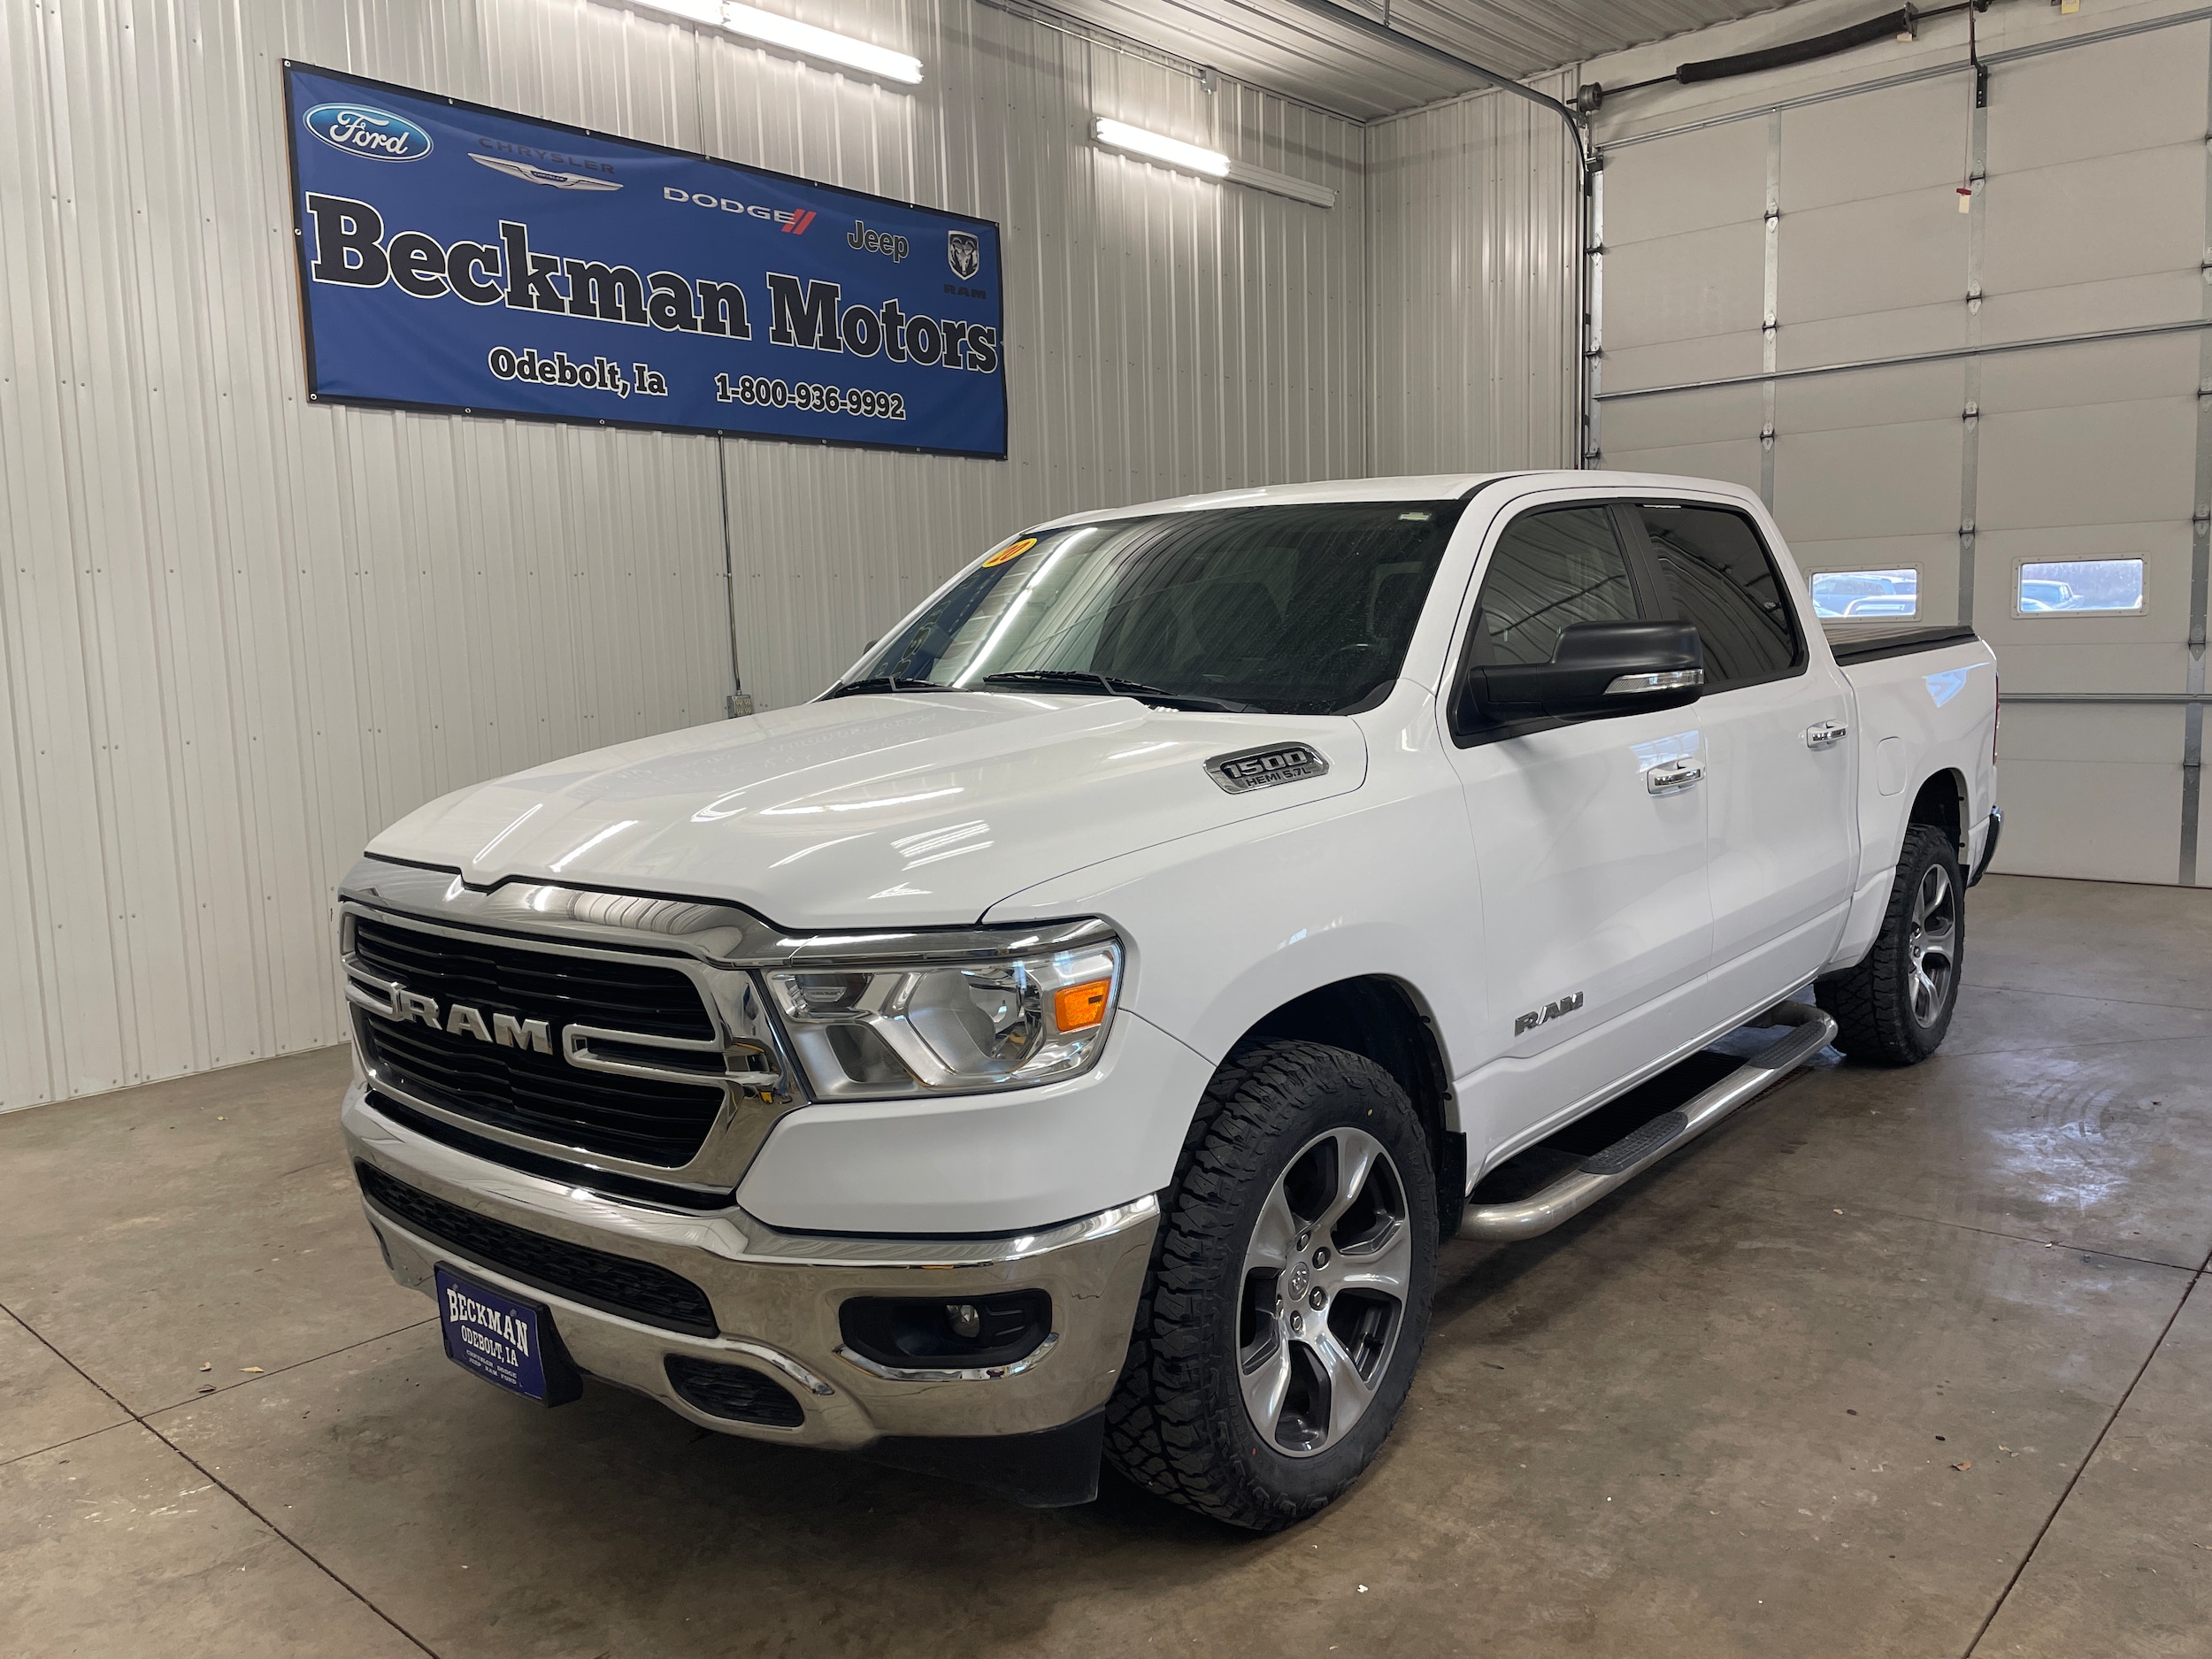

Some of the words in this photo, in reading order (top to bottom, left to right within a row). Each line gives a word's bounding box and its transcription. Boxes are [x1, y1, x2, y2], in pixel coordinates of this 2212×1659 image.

[330, 111, 410, 156] Ford
[478, 137, 616, 175] CHRYSLER
[664, 187, 796, 225] DODGE
[847, 219, 910, 264] Jeep
[305, 190, 752, 342] Beckman
[766, 271, 999, 374] Motors
[943, 283, 987, 300] RAM
[488, 346, 630, 399] Odebolt,
[633, 363, 668, 396] Ia
[714, 372, 906, 420] 1-800-936-9992
[1225, 750, 1308, 779] 1500
[1245, 772, 1282, 787] HEMI
[1283, 767, 1311, 779] 5.7L
[399, 988, 554, 1056] RAM
[1514, 990, 1584, 1037] RAM
[447, 1287, 530, 1357] BECKMAN
[461, 1325, 504, 1363] ODEBOLT,
[505, 1347, 518, 1367] IA
